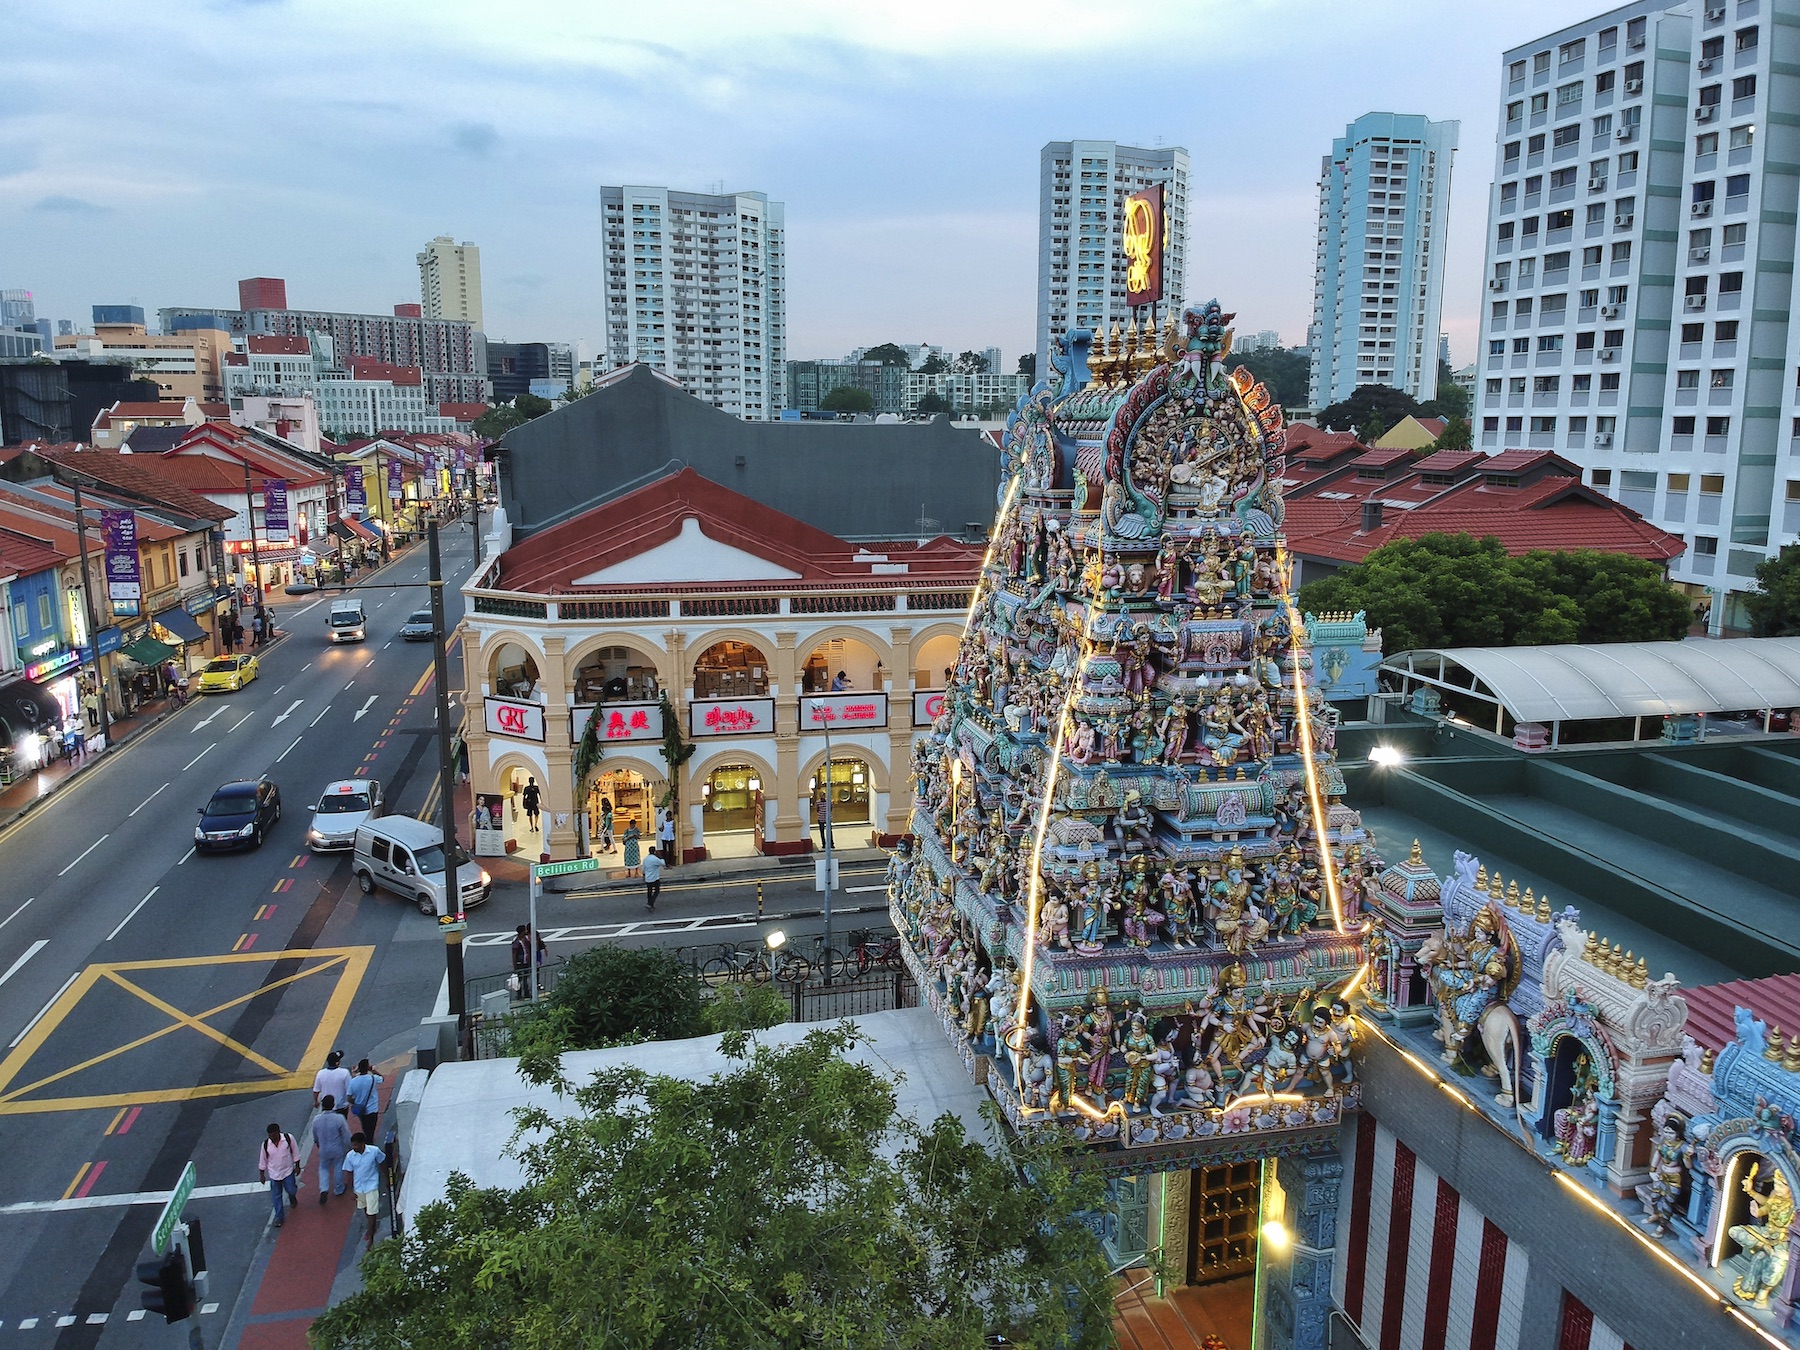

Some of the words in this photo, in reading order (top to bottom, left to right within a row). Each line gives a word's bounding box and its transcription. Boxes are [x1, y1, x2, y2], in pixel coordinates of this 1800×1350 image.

[844, 704, 876, 712] DIAMOND
[842, 712, 876, 720] PLATINUM
[538, 864, 578, 875] Belilios
[582, 860, 594, 869] Rd
[158, 1186, 185, 1246] Serangoon
[186, 1166, 193, 1187] Rd
